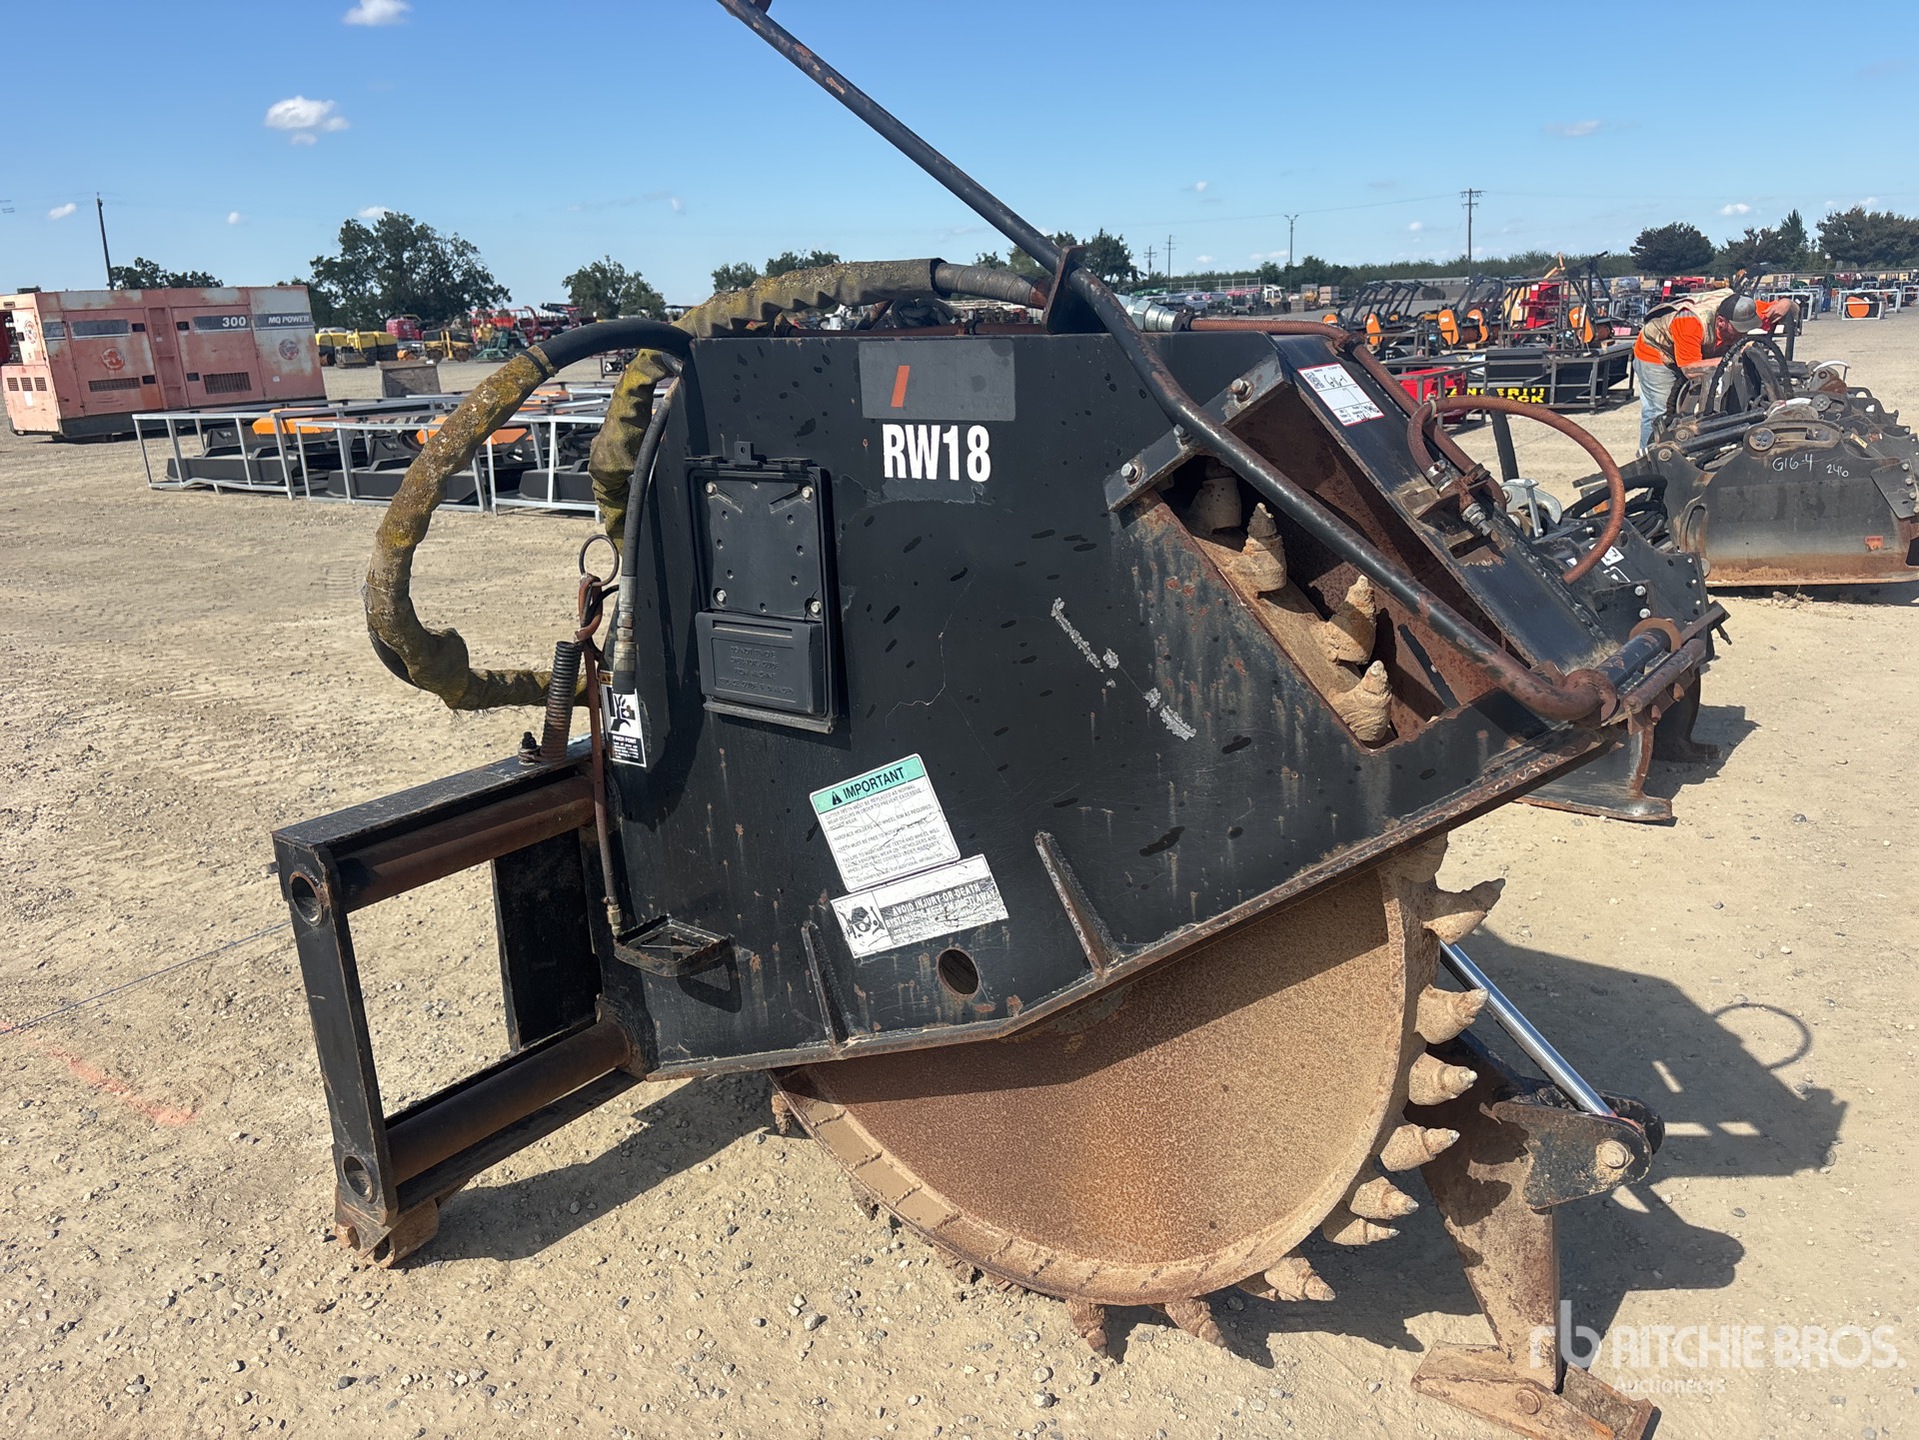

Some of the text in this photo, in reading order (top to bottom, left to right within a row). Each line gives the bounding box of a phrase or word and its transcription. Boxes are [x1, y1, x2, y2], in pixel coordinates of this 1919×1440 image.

[222, 316, 246, 328] 300
[268, 315, 310, 325] MQ POWER
[882, 423, 991, 482] RW18
[1772, 453, 1849, 477] G16-4 246
[842, 766, 906, 799] IMPORTANT
[891, 901, 915, 916] AVOID
[913, 893, 942, 909] INJURY
[953, 881, 981, 898] DEATH
